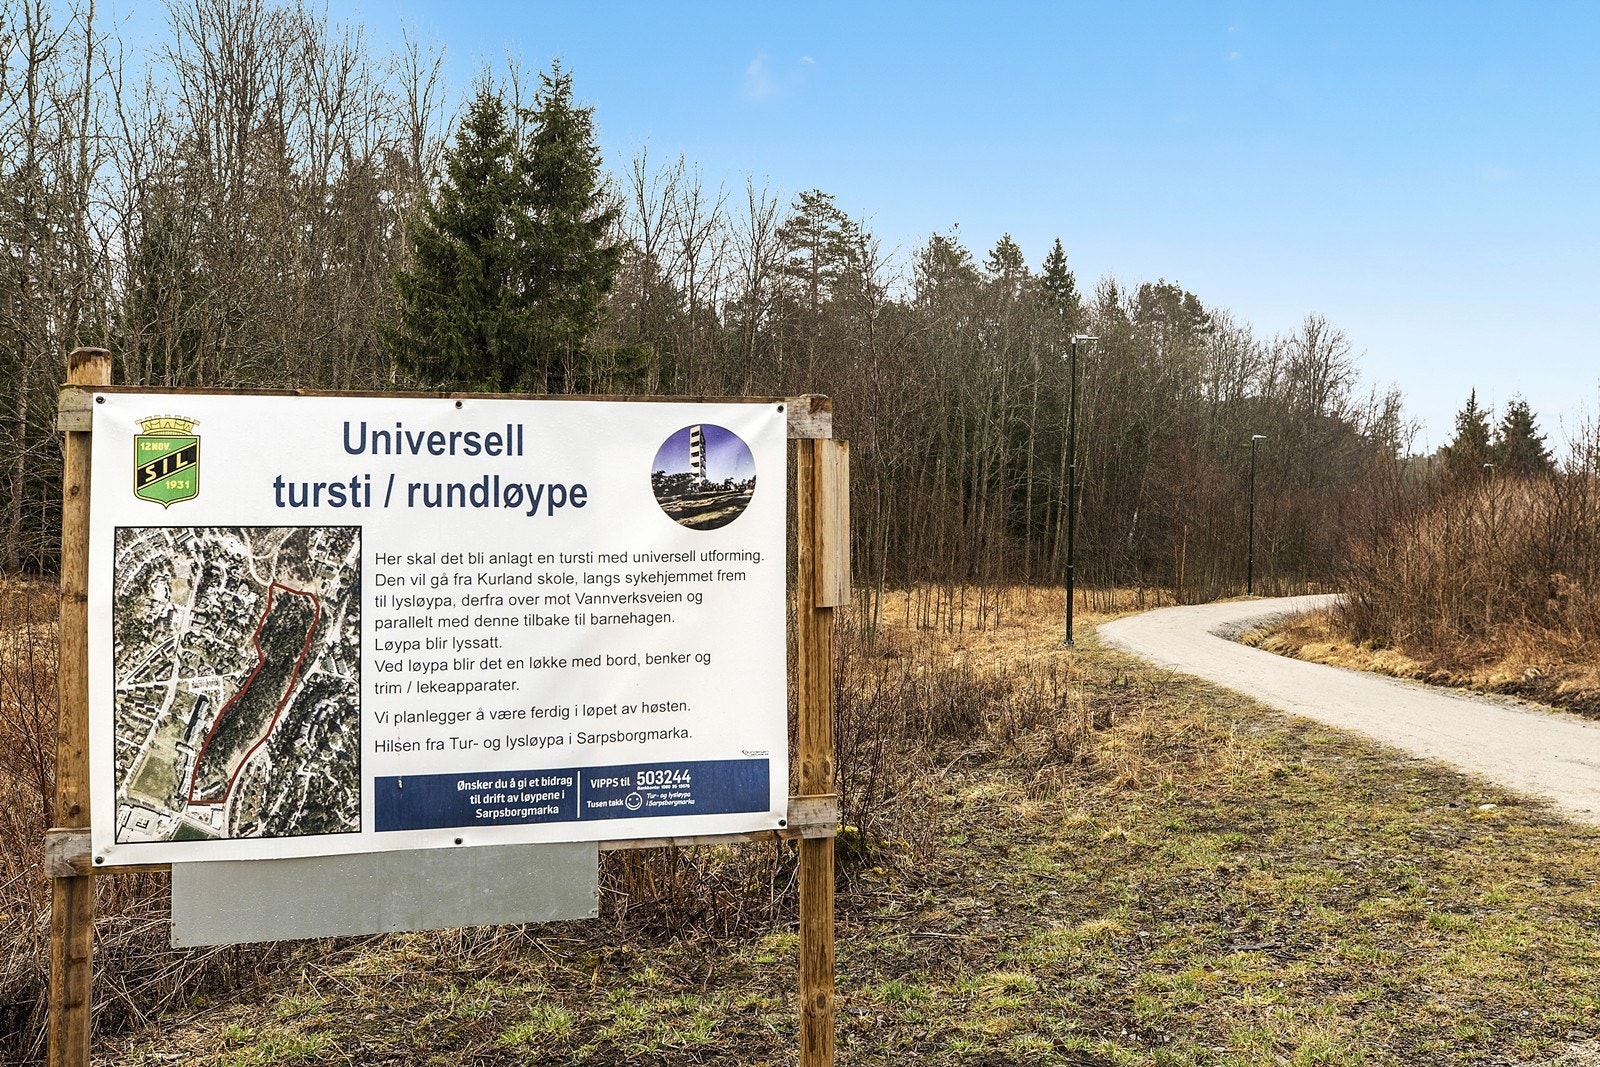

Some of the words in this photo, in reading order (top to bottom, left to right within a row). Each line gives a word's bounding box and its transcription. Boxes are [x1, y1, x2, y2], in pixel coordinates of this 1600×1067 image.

[344, 422, 522, 456] Universell
[165, 480, 190, 489] 1931
[273, 474, 370, 507] tursti
[384, 474, 394, 507] /
[409, 475, 587, 516] rundløype
[376, 553, 402, 565] Her
[407, 553, 435, 565] skal
[441, 553, 463, 564] det
[469, 552, 483, 564] bli
[489, 552, 532, 567] anlagt
[538, 555, 554, 564] en
[560, 552, 592, 563] tursti
[599, 552, 627, 563] med
[633, 550, 695, 562] universell
[701, 550, 764, 564] utforming.
[376, 574, 404, 586] Den
[411, 574, 425, 585] vil
[431, 573, 448, 589] gå
[454, 573, 471, 585] fra
[478, 573, 532, 585] Kurland
[538, 572, 577, 585] skole,
[584, 572, 620, 587] langs
[626, 571, 713, 586] sykehjemmet
[717, 570, 745, 581] frem
[375, 595, 386, 607] til
[392, 595, 455, 610] lysløypa,
[462, 594, 503, 606] derfra
[509, 596, 539, 605] over
[545, 594, 570, 605] mot
[575, 591, 682, 604] Vannverksveien
[687, 593, 702, 604] og
[375, 616, 432, 631] parallelt
[438, 615, 468, 627] med
[475, 615, 519, 627] denne
[524, 614, 569, 626] tilbake
[575, 613, 585, 625] til
[591, 612, 674, 626] barnehagen.
[376, 639, 420, 653] Løypa
[426, 637, 447, 649] blir
[453, 637, 502, 652] lyssatt.
[375, 660, 402, 672] Ved
[409, 658, 447, 674] løypa
[454, 658, 475, 670] blir
[480, 658, 502, 670] det
[507, 660, 523, 669] en
[530, 656, 567, 668] løkke
[572, 655, 601, 667] med
[607, 654, 640, 666] bord,
[646, 652, 691, 664] benker
[695, 653, 710, 665] og
[375, 682, 401, 694] trim
[407, 681, 411, 693] /
[417, 680, 518, 694] lekeapparater.
[375, 711, 388, 723] Vi
[395, 710, 471, 726] planlegger
[476, 708, 484, 720] å
[490, 710, 526, 720] være
[531, 705, 569, 720] ferdig
[575, 705, 578, 716] i
[583, 704, 617, 718] løpet
[622, 705, 637, 714] av
[642, 701, 690, 713] høsten.
[375, 737, 420, 752] Hilsen
[426, 738, 444, 750] fra
[450, 737, 478, 749] Tur-
[484, 739, 500, 751] og
[507, 735, 563, 750] lysløypa
[568, 733, 572, 744] i
[577, 727, 691, 745] Sarpsborgmarka.
[457, 779, 494, 792] Ønsker
[494, 778, 508, 789] du
[509, 777, 516, 789] å
[517, 777, 527, 790] gi
[528, 777, 540, 788] et
[541, 776, 573, 787] bidrag
[590, 777, 619, 789] VIPPS
[620, 777, 631, 787] til
[636, 769, 691, 785] 503244
[469, 794, 482, 805] til
[482, 793, 506, 804] drift
[506, 794, 520, 803] av
[520, 791, 560, 804] løypene
[561, 789, 565, 799] i
[587, 800, 608, 808] Tusen
[608, 799, 624, 807] takk
[475, 804, 559, 820] Sarpsborgmarka
